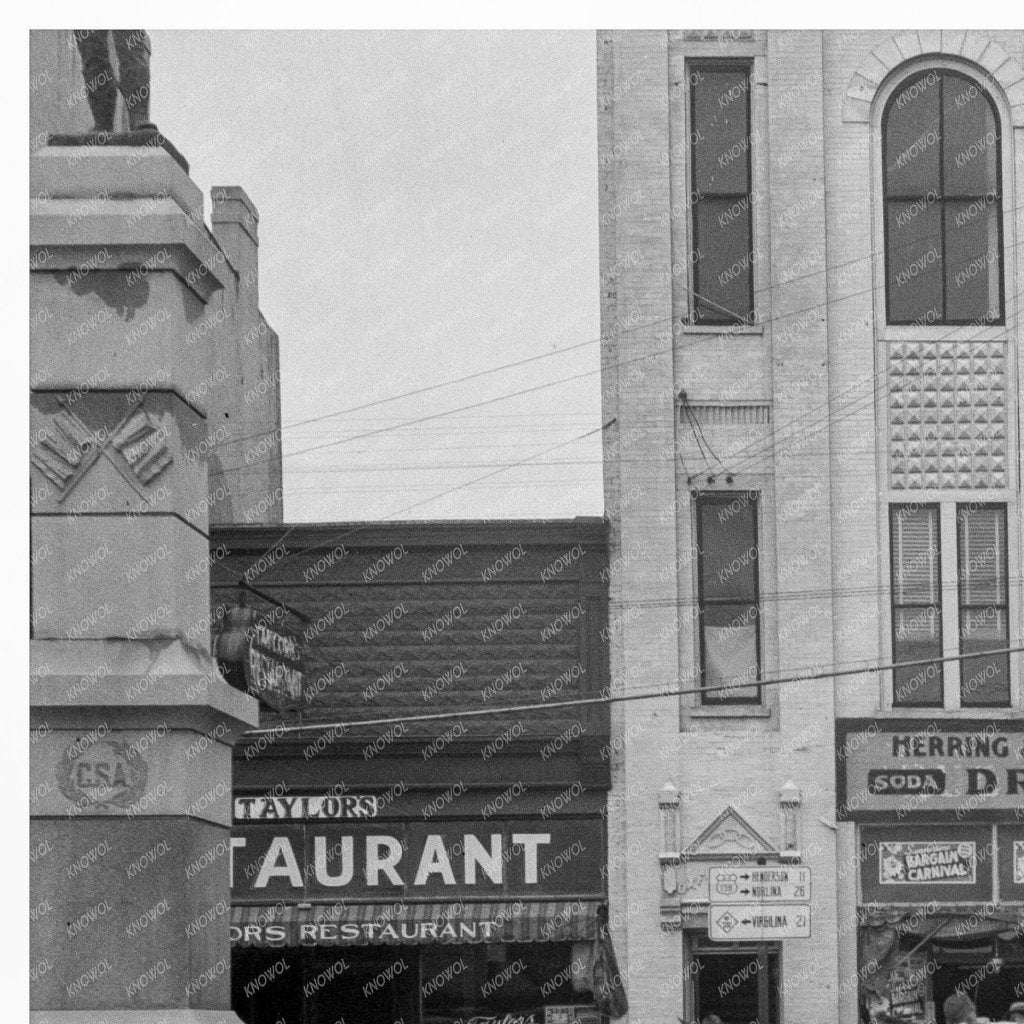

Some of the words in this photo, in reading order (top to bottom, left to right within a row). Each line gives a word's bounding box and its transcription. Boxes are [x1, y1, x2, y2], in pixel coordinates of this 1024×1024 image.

[892, 735, 1009, 758] HERRING
[77, 762, 127, 787] CSA
[874, 774, 939, 790] SODA
[238, 796, 375, 819] TAYLORS
[906, 850, 960, 869] BARGAIN
[752, 871, 788, 882] HENDERSON
[907, 863, 968, 881] CARNIVAL
[752, 885, 782, 897] NORLINA
[794, 885, 806, 897] 26
[752, 915, 787, 928] VIRGILINA
[796, 914, 806, 928] 21
[301, 921, 497, 943] RESTAURANT
